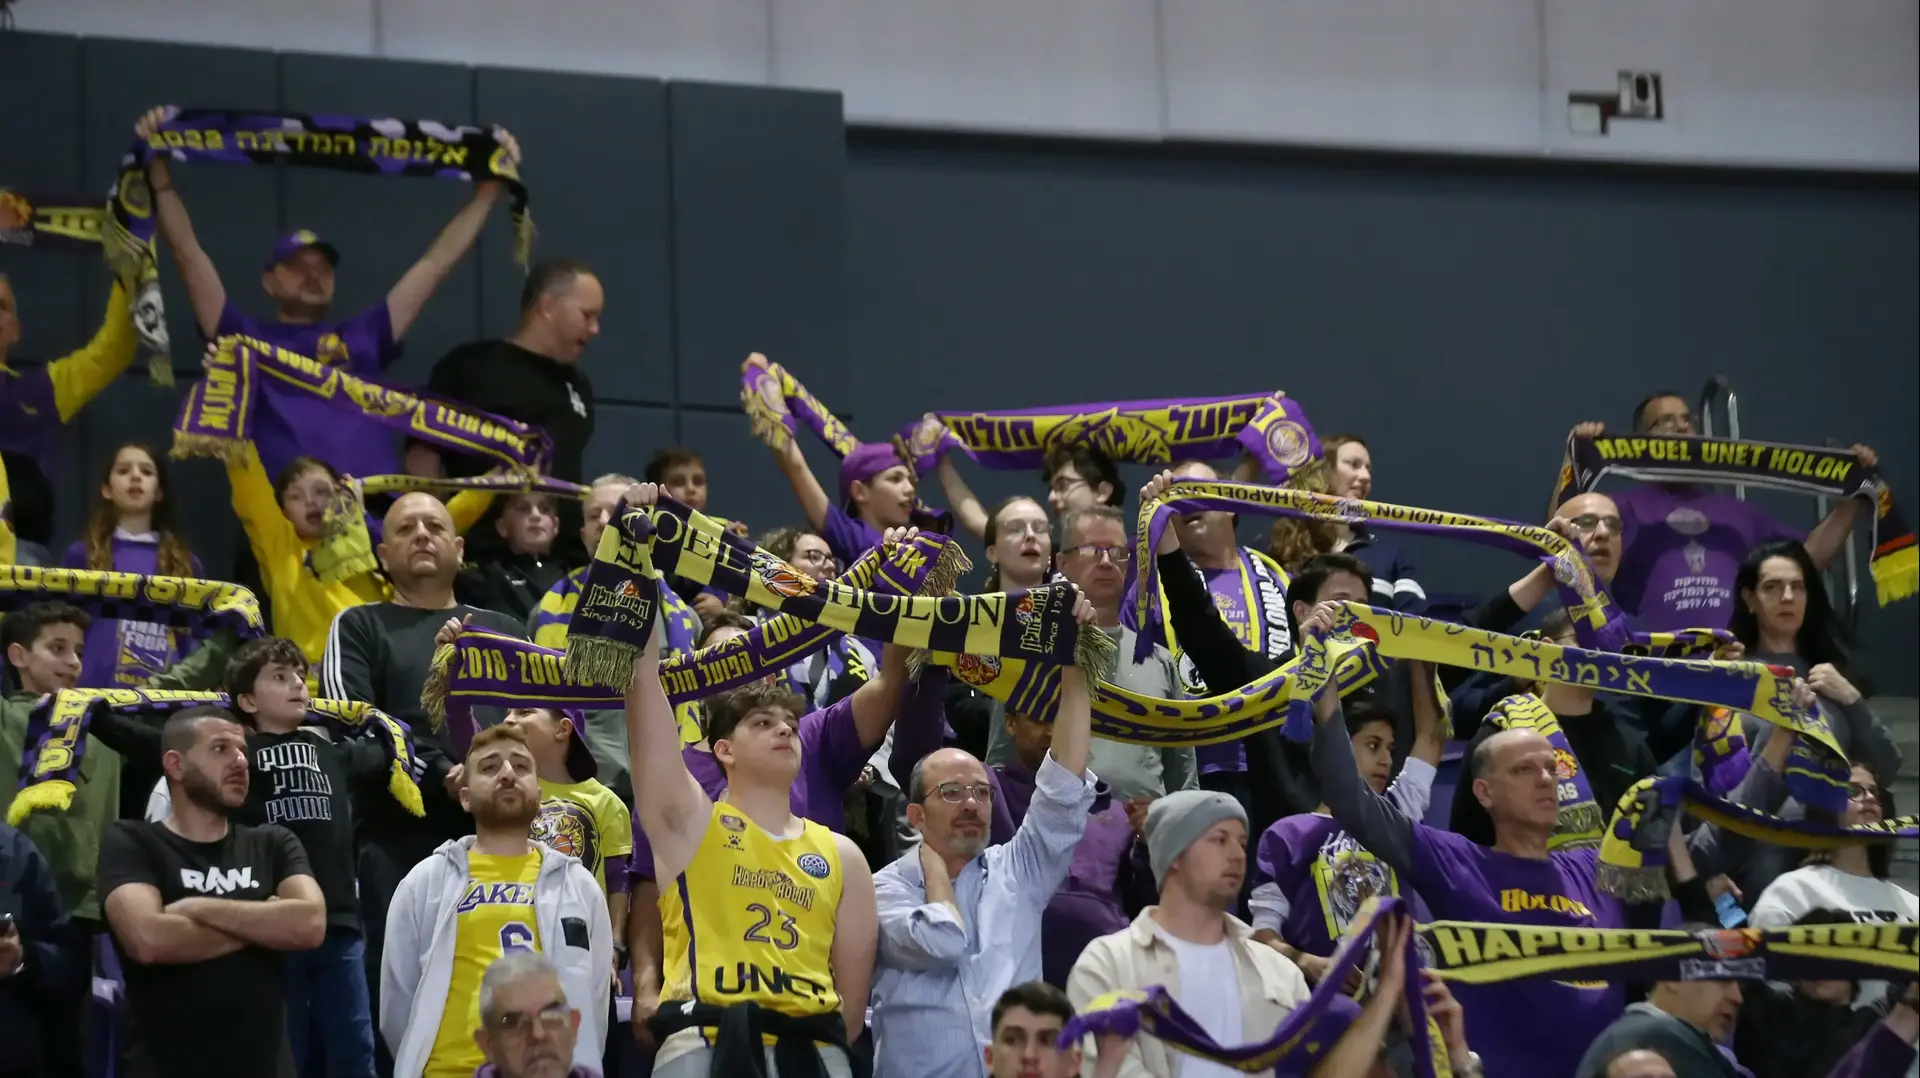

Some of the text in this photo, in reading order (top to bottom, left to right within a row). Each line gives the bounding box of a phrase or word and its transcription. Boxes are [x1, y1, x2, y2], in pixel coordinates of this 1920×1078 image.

[1595, 437, 1854, 482] HAPOEL UNET HOLON
[1210, 484, 1289, 505] HAPOEL
[826, 581, 1004, 627] HOLON
[1049, 584, 1067, 614] 1947
[580, 606, 643, 630] Since 1947
[456, 645, 508, 681] 2018
[660, 650, 754, 697] הפועל חולו
[1469, 642, 1655, 695] אימפריה
[256, 741, 321, 772] PUMA
[265, 795, 332, 824] PUMA
[180, 866, 260, 895] RAW.
[456, 879, 535, 914] LAKE
[775, 883, 816, 912] HOLON
[743, 902, 799, 950] 23
[1443, 927, 1666, 967] HAPOEL
